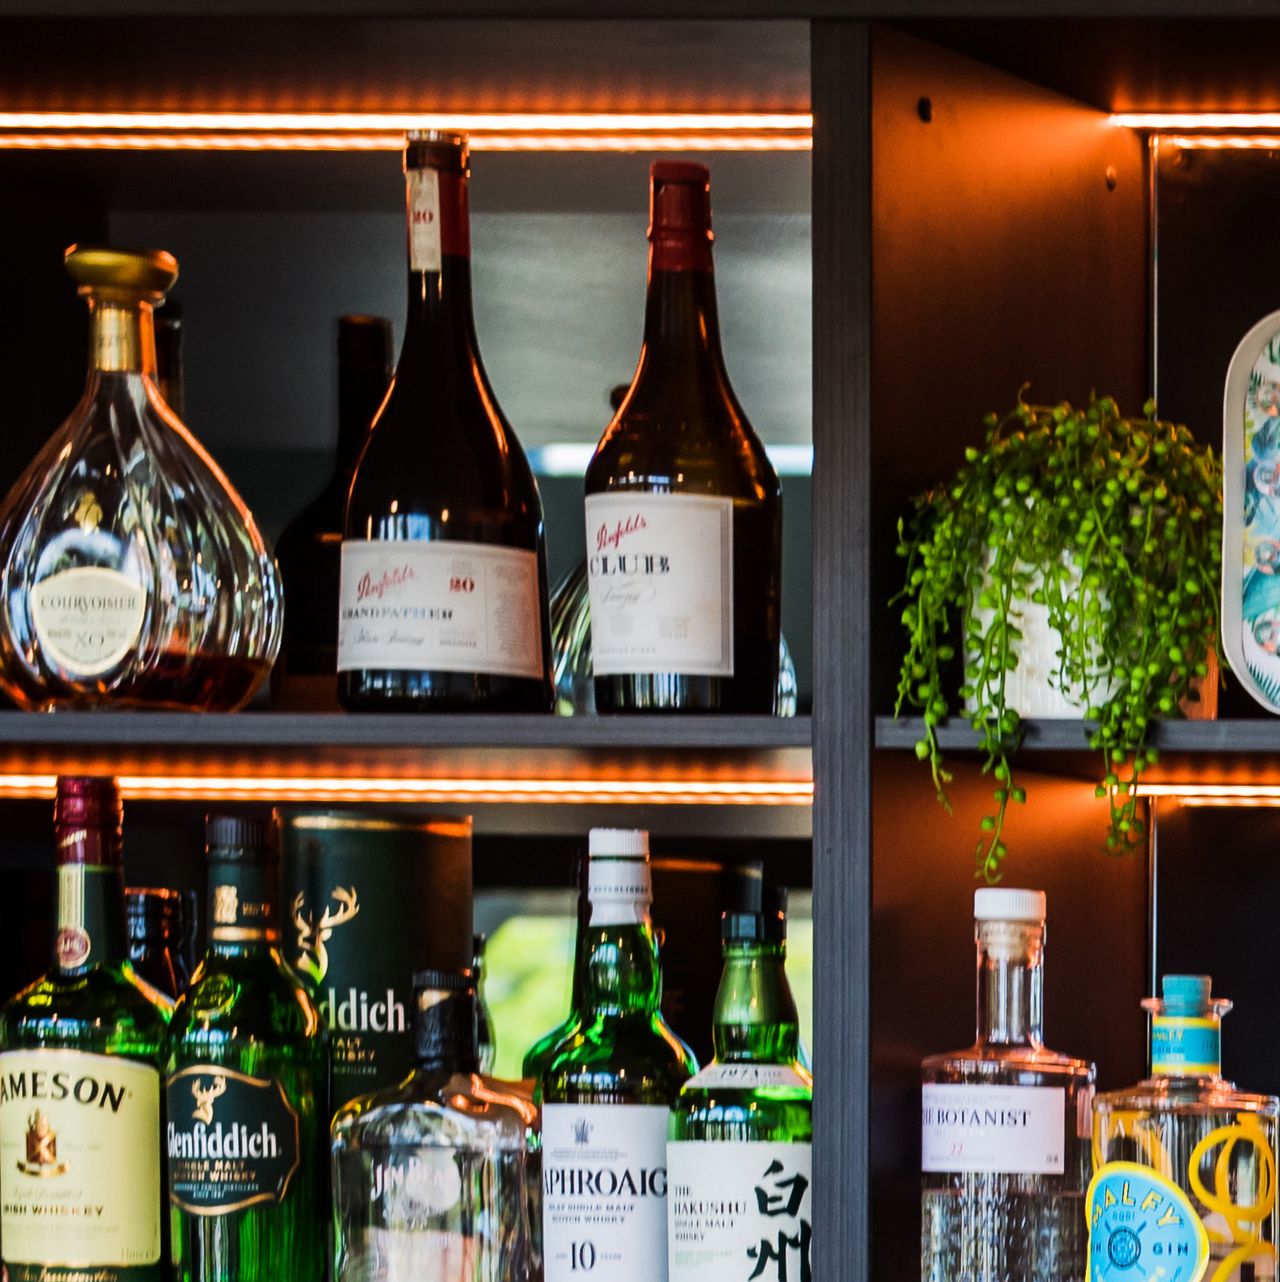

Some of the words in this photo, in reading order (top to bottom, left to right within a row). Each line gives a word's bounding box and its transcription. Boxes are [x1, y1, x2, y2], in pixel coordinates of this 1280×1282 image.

[590, 553, 670, 575] CLUB
[40, 594, 138, 612] COURVOISIER
[0, 1071, 126, 1113] AMESON
[937, 1108, 1031, 1127] BOTANIST
[167, 1121, 277, 1158] Glenfiddich
[32, 1205, 104, 1216] WHISKEY
[675, 1201, 746, 1216] HAKUSHU
[1092, 1180, 1184, 1228] MALFY
[570, 1240, 597, 1271] 10
[1153, 1242, 1189, 1256] GIN
